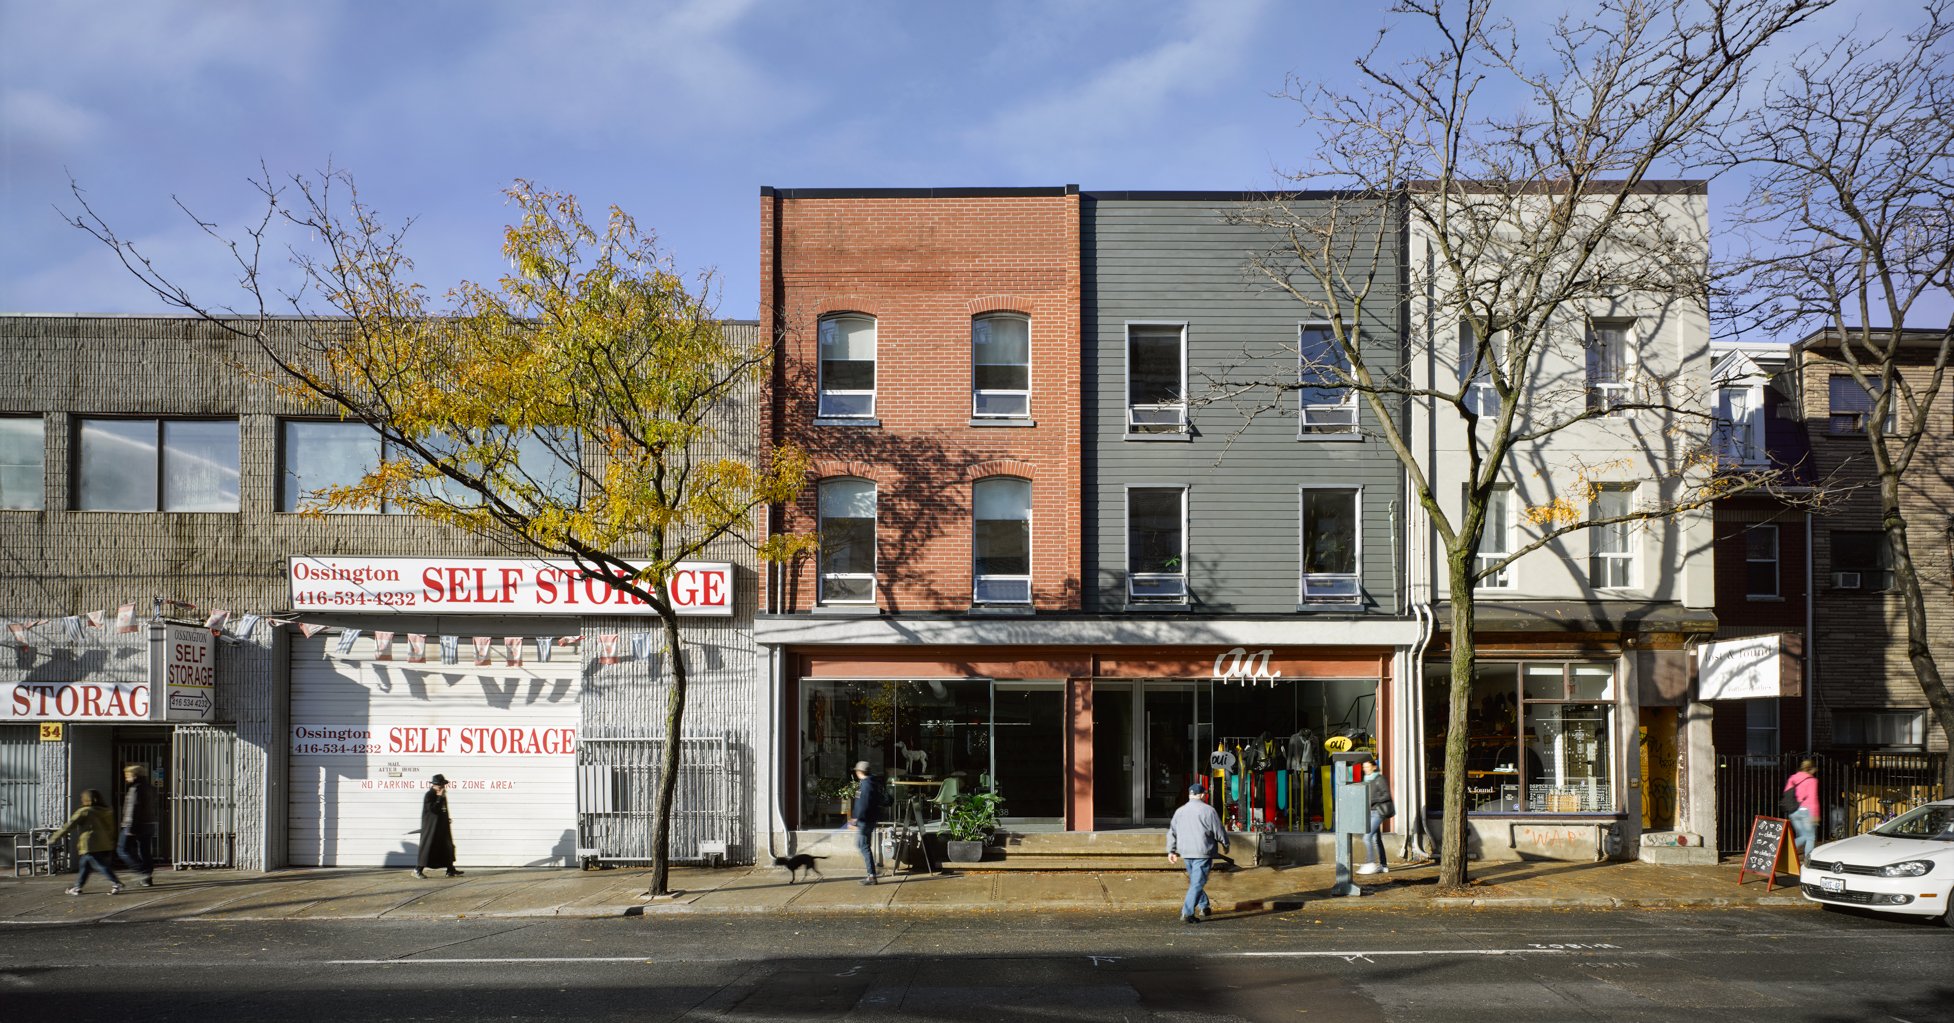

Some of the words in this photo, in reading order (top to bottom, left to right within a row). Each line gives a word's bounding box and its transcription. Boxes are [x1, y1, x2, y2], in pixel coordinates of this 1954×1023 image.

[293, 562, 399, 585] Ossington
[422, 566, 523, 604] SELF
[295, 590, 416, 606] 416-534-4232
[174, 629, 207, 643] OSSINGTON
[175, 643, 207, 664] SELF
[168, 663, 213, 686] STORAGE
[183, 699, 193, 707] 534
[41, 725, 61, 738] 34
[295, 726, 371, 742] Ossington
[294, 743, 382, 754] 416-534-4232
[389, 727, 451, 754] SELF
[460, 727, 576, 755] STORAGE
[361, 780, 373, 789] NO
[377, 780, 415, 789] PARKING
[462, 780, 485, 789] ZONE
[490, 780, 513, 789] AREA
